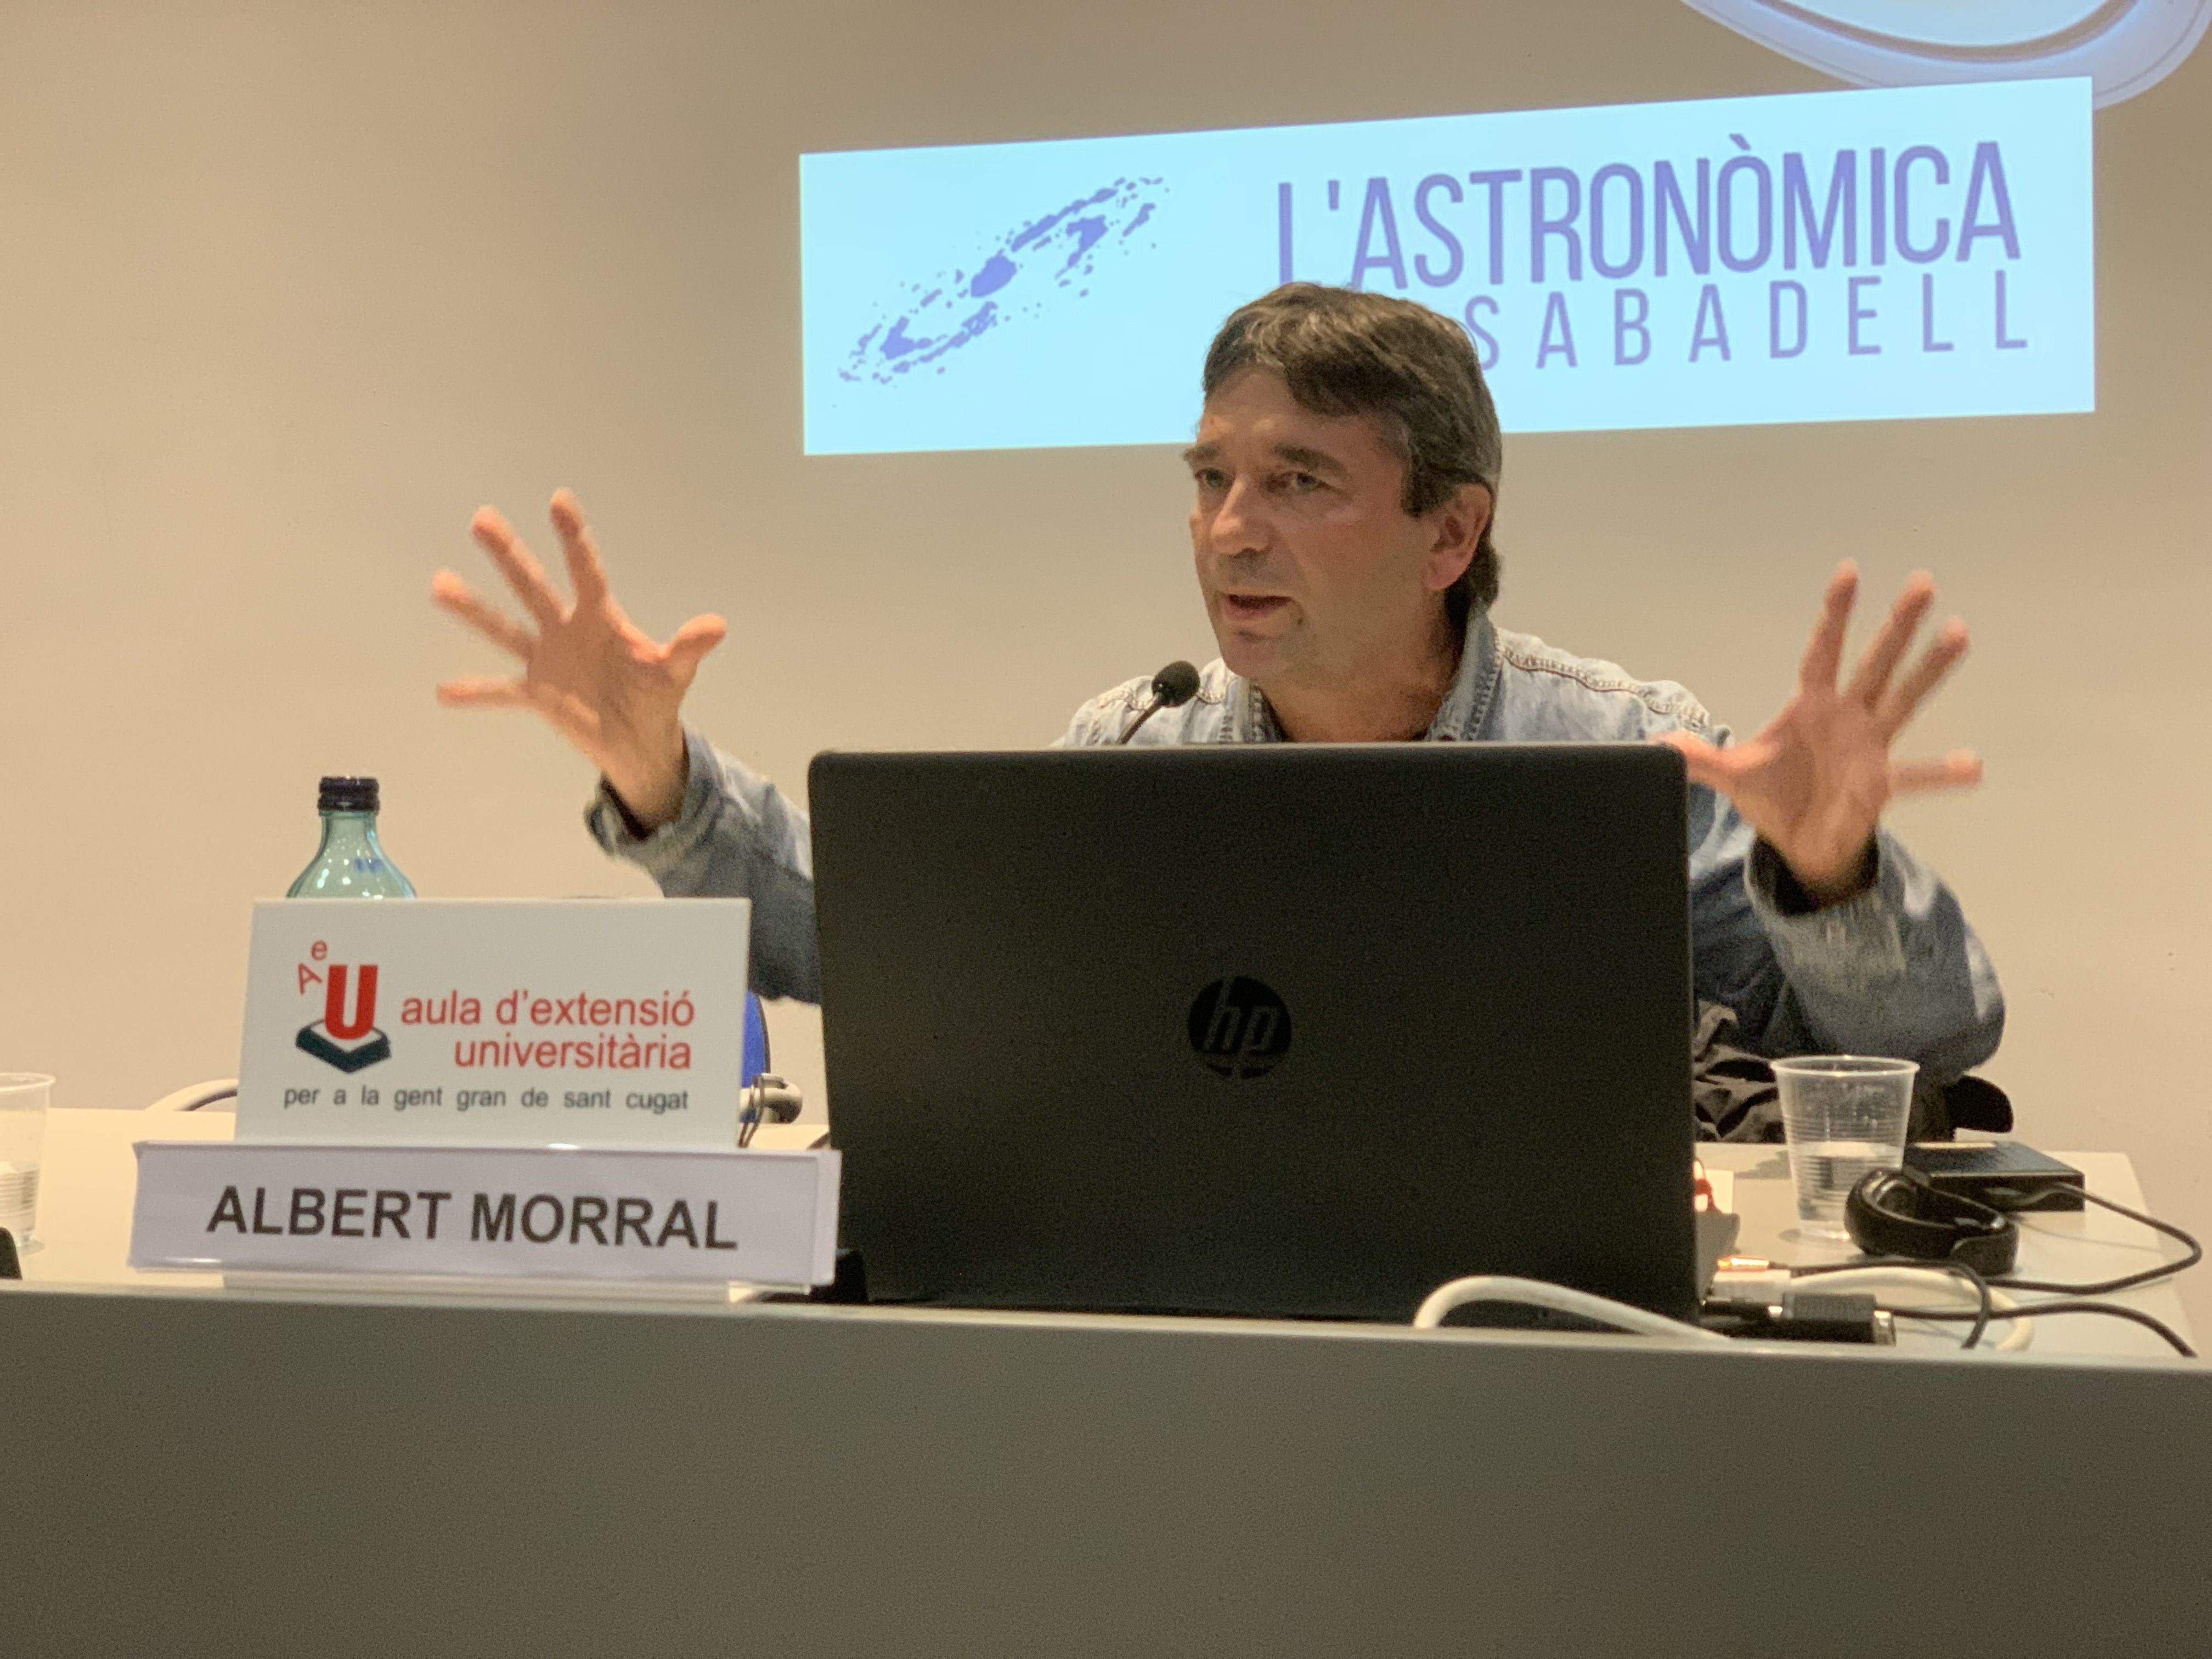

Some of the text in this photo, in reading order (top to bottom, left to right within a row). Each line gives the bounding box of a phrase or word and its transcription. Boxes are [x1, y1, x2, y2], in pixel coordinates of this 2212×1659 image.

[1464, 269, 2028, 371] SABADELL
[400, 990, 482, 1025] aula
[1201, 978, 1280, 1076] hp
[454, 1032, 692, 1069] universitària
[283, 1085, 690, 1115] per a la gent gran de sant cugat
[206, 1185, 738, 1250] ALBERT MORRAL
